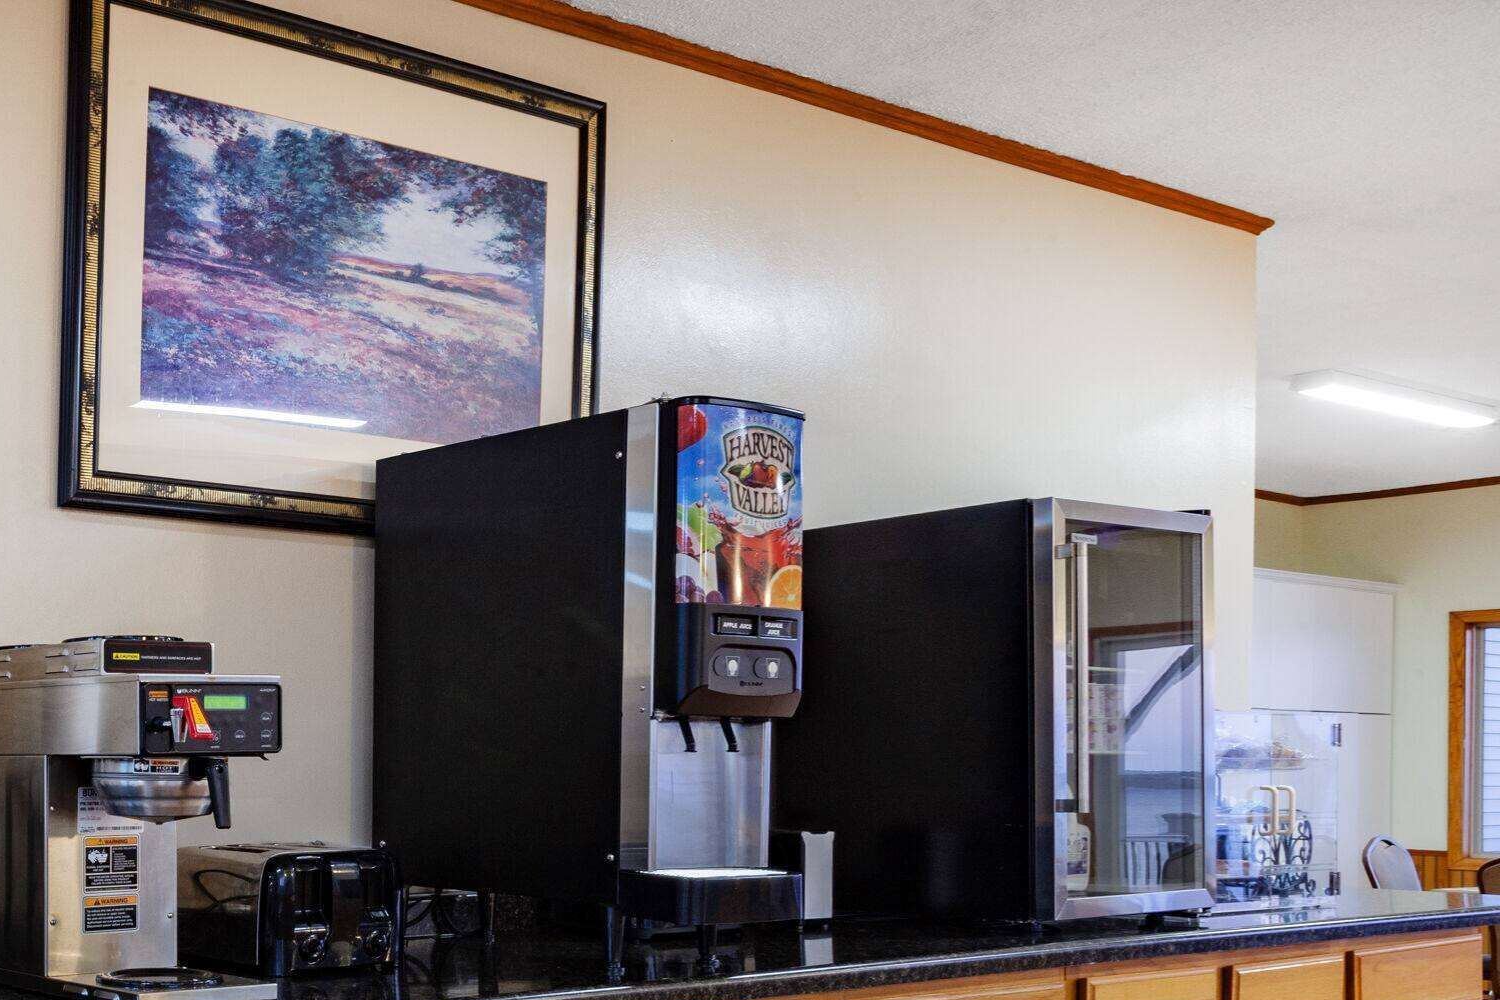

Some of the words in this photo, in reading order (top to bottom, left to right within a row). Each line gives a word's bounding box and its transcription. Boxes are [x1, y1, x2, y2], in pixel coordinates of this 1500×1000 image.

[728, 431, 795, 471] HARVEST
[736, 481, 787, 515] VALLEY
[722, 621, 739, 629] APPLE
[739, 622, 754, 630] JUICE
[82, 788, 99, 797] BUN
